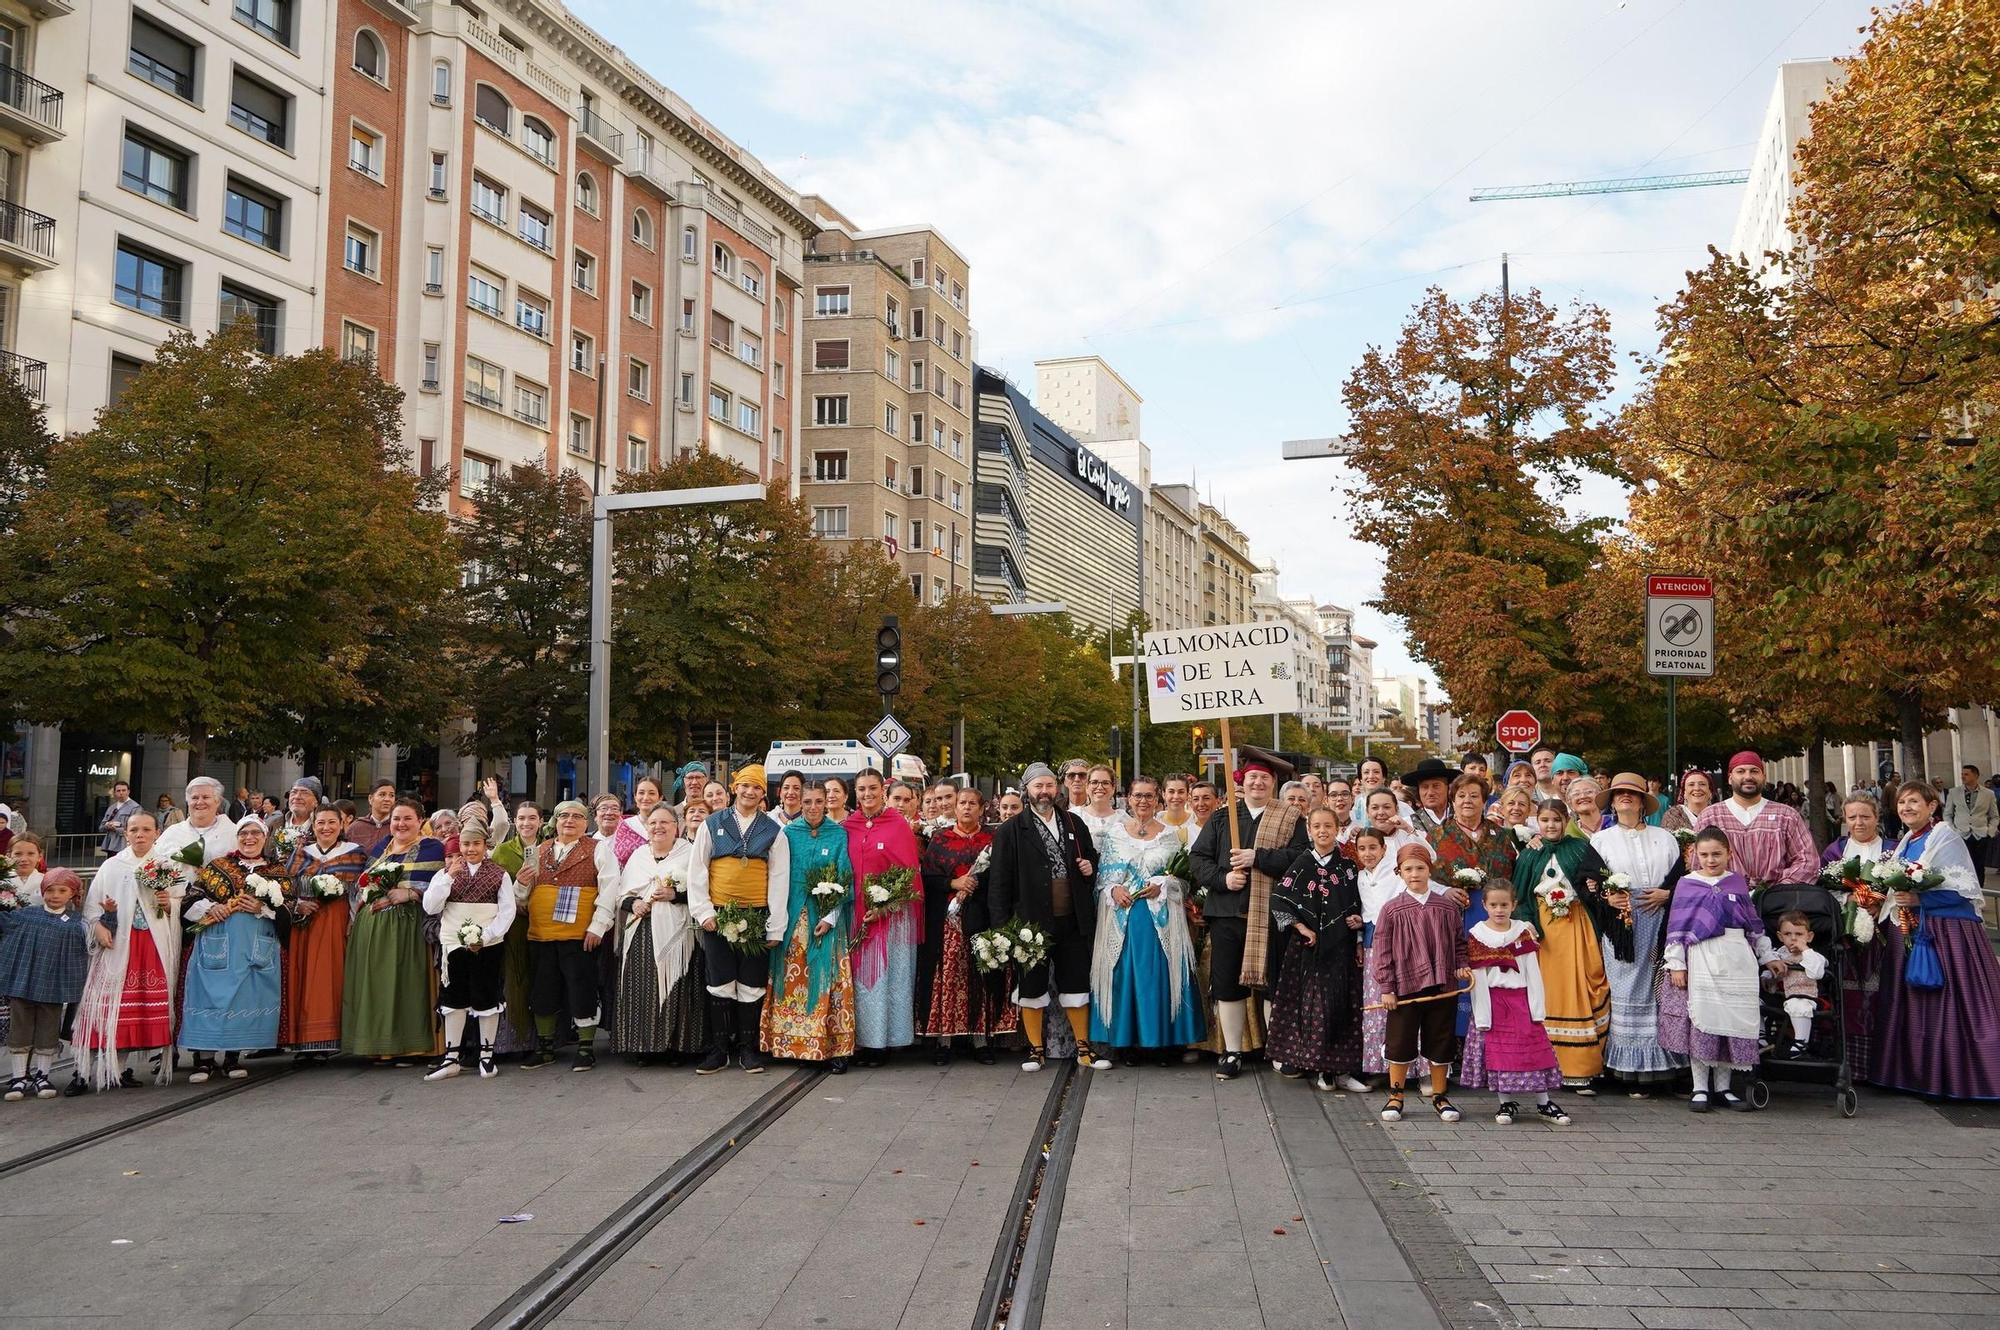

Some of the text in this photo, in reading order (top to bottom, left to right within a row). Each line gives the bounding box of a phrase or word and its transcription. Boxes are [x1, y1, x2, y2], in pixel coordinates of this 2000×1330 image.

[1078, 447, 1087, 478] El
[1088, 456, 1106, 491] Corte
[1665, 615, 1697, 635] 20
[1147, 626, 1289, 657] ALMONACID
[1655, 649, 1707, 658] PRIORIDAD
[1183, 659, 1255, 682] DE LA
[1656, 661, 1706, 670] PEATONAL
[1181, 688, 1264, 711] SIERRA
[879, 729, 898, 744] 30
[1502, 727, 1536, 736] STOP
[89, 763, 118, 776] Aural
[777, 757, 848, 767] AMBULANCIA
